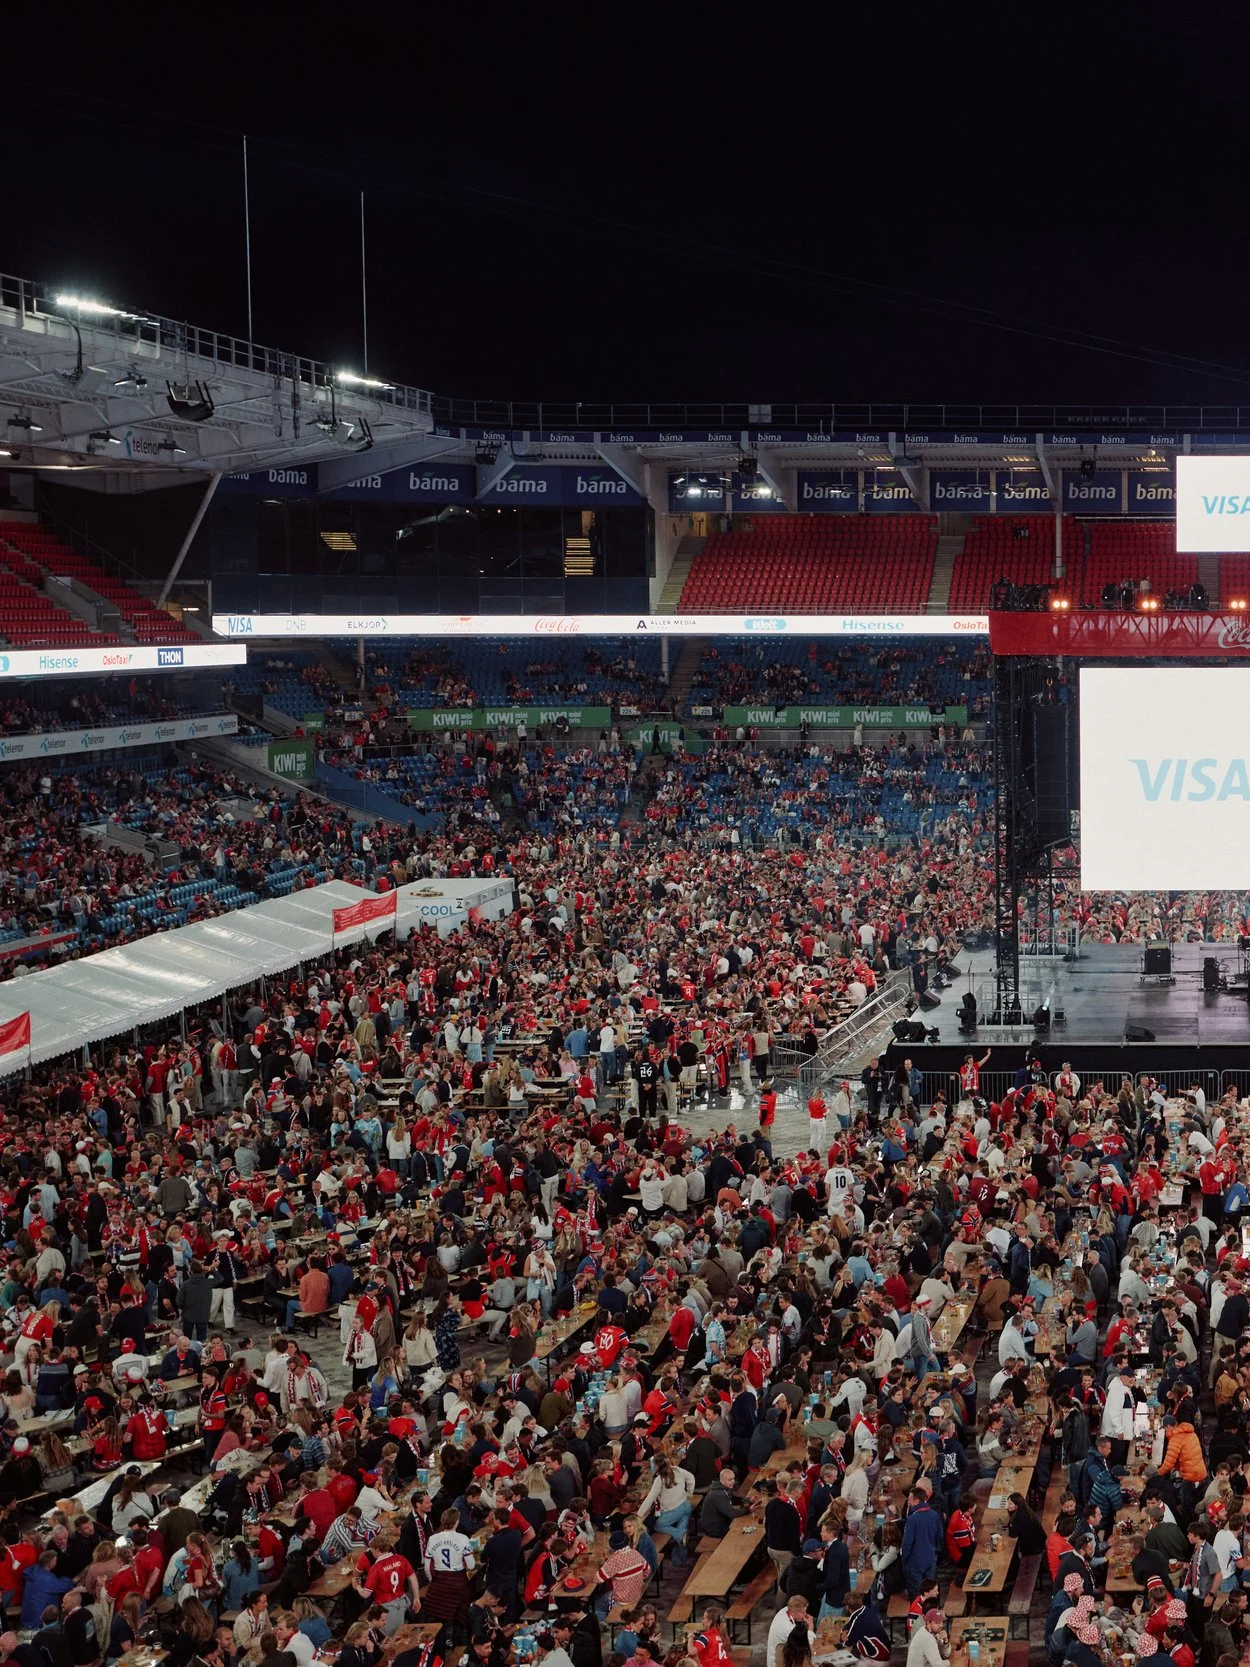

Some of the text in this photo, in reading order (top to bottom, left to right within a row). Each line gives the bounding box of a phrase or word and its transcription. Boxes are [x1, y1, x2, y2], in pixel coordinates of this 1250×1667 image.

[484, 431, 505, 441] bama
[550, 432, 575, 442] bama
[610, 432, 634, 442] bama
[659, 432, 683, 442] bama
[708, 432, 732, 442] bama
[758, 432, 782, 442] bama
[807, 432, 831, 442] bama
[856, 432, 880, 442] bama
[904, 433, 929, 443] bama
[954, 433, 978, 443] bama
[1003, 433, 1027, 443] bama
[1052, 434, 1076, 443] bama
[1101, 434, 1125, 443] bama
[1150, 434, 1175, 444] bama
[268, 469, 307, 485] bama
[410, 472, 459, 491] bama
[577, 476, 627, 493] bama
[1069, 483, 1116, 499] bama
[229, 617, 253, 633] VISA
[842, 619, 905, 630] Hisense
[39, 650, 182, 669] Hisense OsloTaxi THON
[433, 713, 460, 726] KIWI
[486, 712, 514, 725] KIWI
[747, 711, 774, 723] KIWI
[800, 711, 827, 723] KIWI
[853, 711, 879, 723] KIWI
[906, 711, 932, 723] KIWI
[193, 723, 209, 734] telenor
[223, 719, 237, 730] telenor
[125, 731, 142, 742] telenor
[160, 727, 176, 738] telenor
[48, 739, 66, 750] telenor
[88, 735, 106, 746] telenor
[4, 743, 24, 754] telenor
[273, 753, 296, 773] KIWI
[834, 1175, 846, 1189] 10
[441, 1548, 451, 1569] 9
[383, 1561, 402, 1572] HAALAND
[390, 1570, 399, 1593] 9
